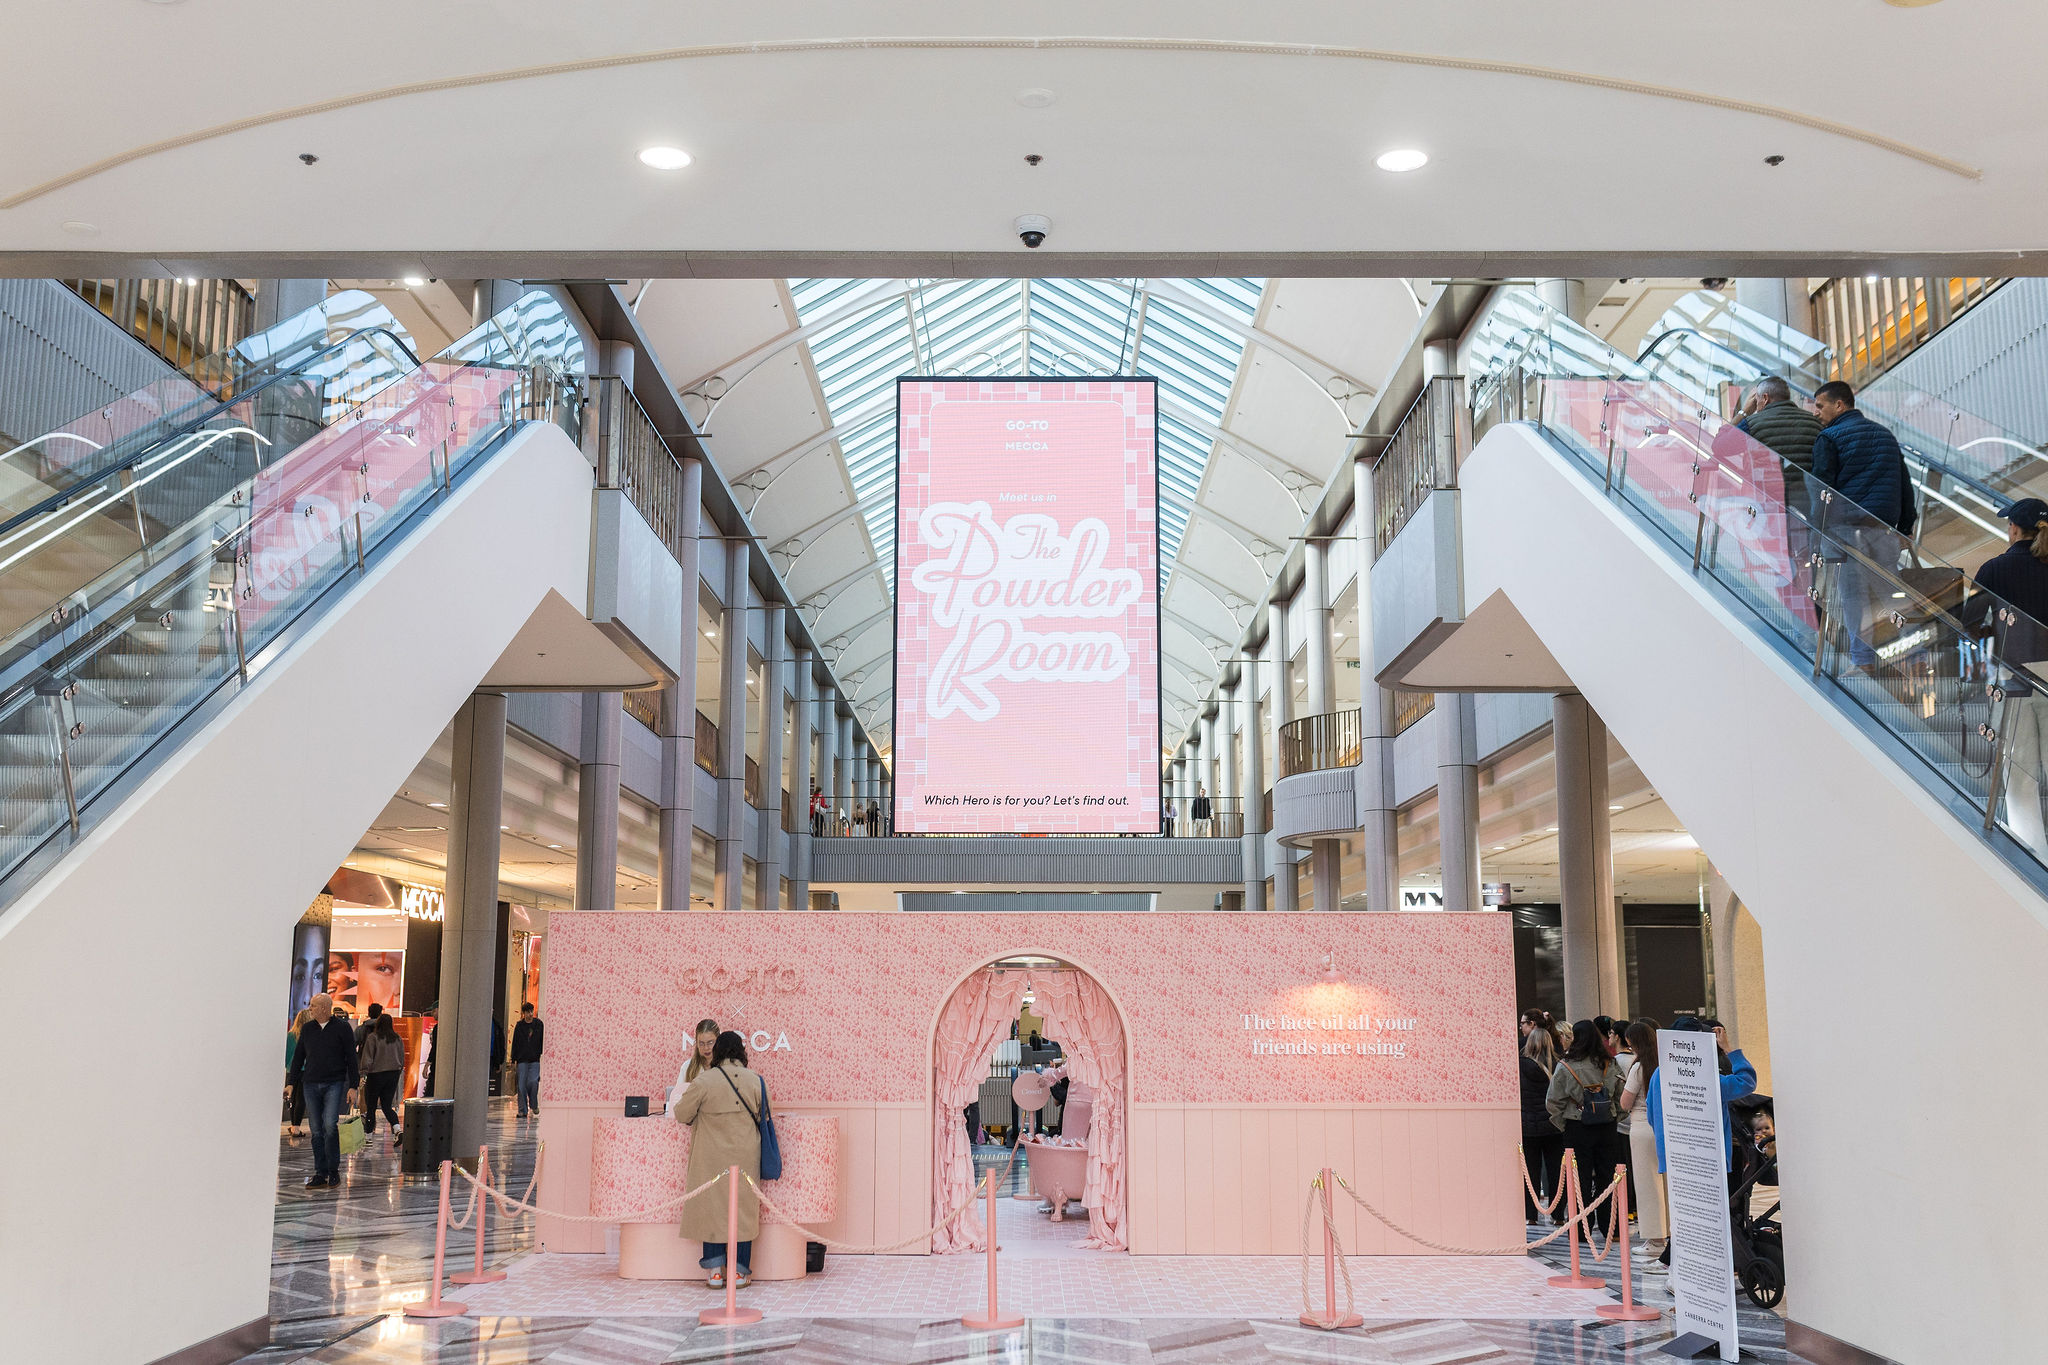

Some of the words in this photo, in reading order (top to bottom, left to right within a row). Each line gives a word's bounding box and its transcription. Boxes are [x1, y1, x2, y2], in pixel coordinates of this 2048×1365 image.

[1006, 420, 1049, 431] GO-TO
[1005, 442, 1049, 451] MECCA
[999, 492, 1028, 502] Meet
[1031, 494, 1044, 502] us
[1046, 492, 1057, 502] in
[1010, 524, 1061, 560] The
[922, 511, 1132, 616] Powder
[937, 608, 1119, 711] Room
[924, 795, 959, 806] Which
[963, 795, 990, 806] Hero
[993, 795, 1002, 806] is
[1004, 795, 1020, 806] for
[1023, 795, 1051, 808] you?
[1053, 795, 1080, 806] Let's
[1082, 795, 1105, 806] find
[1108, 795, 1130, 806] out.
[401, 886, 445, 922] MECCA
[677, 963, 801, 992] GO-TO
[1239, 1014, 1276, 1031] The
[1280, 1014, 1317, 1031] face
[1321, 1014, 1343, 1031] oil
[1348, 1014, 1371, 1031] all
[1374, 1017, 1417, 1034] your
[682, 1030, 792, 1052] MCA
[1252, 1039, 1317, 1056] friends
[1321, 1042, 1351, 1056] are
[1356, 1039, 1406, 1059] using
[1672, 1040, 1691, 1052] Filming
[1691, 1041, 1696, 1050] &
[1668, 1053, 1703, 1066] Photography
[1677, 1067, 1696, 1077] Notice
